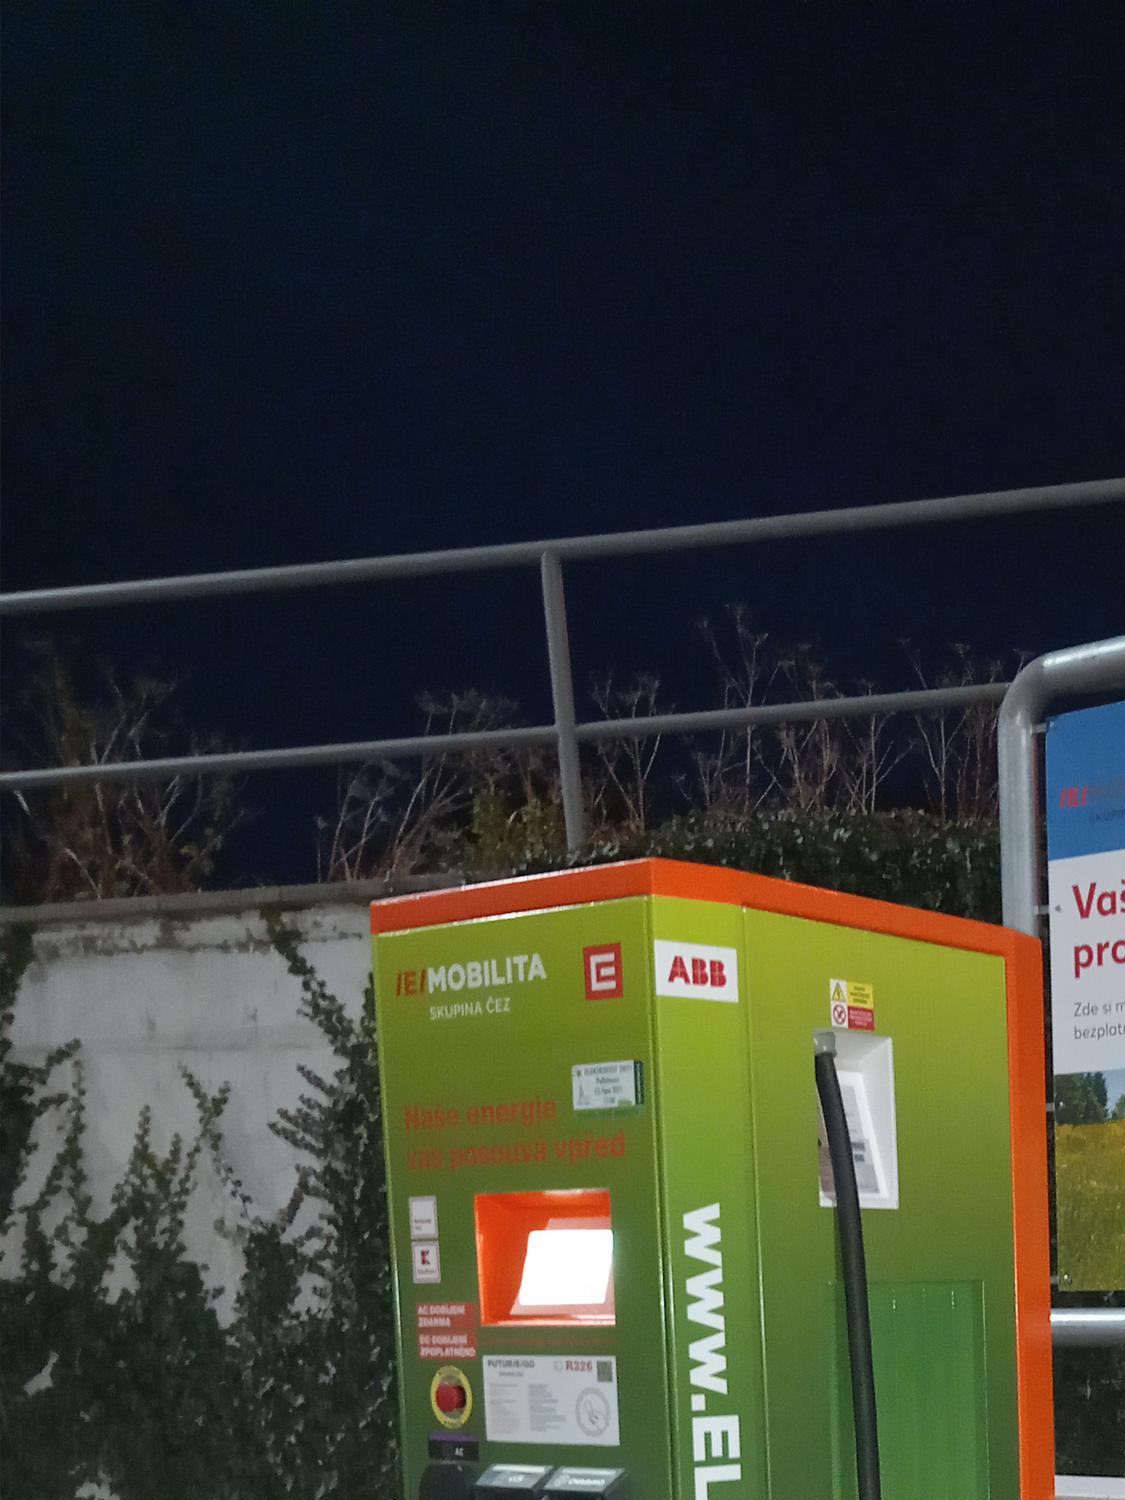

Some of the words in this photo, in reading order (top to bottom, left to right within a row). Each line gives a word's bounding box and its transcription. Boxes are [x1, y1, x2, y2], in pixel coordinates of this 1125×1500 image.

[668, 955, 727, 988] ABB
[429, 1001, 482, 1020] SKUPINA
[486, 996, 511, 1014] ČEZ
[1073, 1001, 1099, 1017] Zde
[1101, 1000, 1112, 1014] si
[467, 1098, 559, 1127] energie
[554, 1129, 626, 1167] vpřed
[565, 1359, 593, 1372] R326
